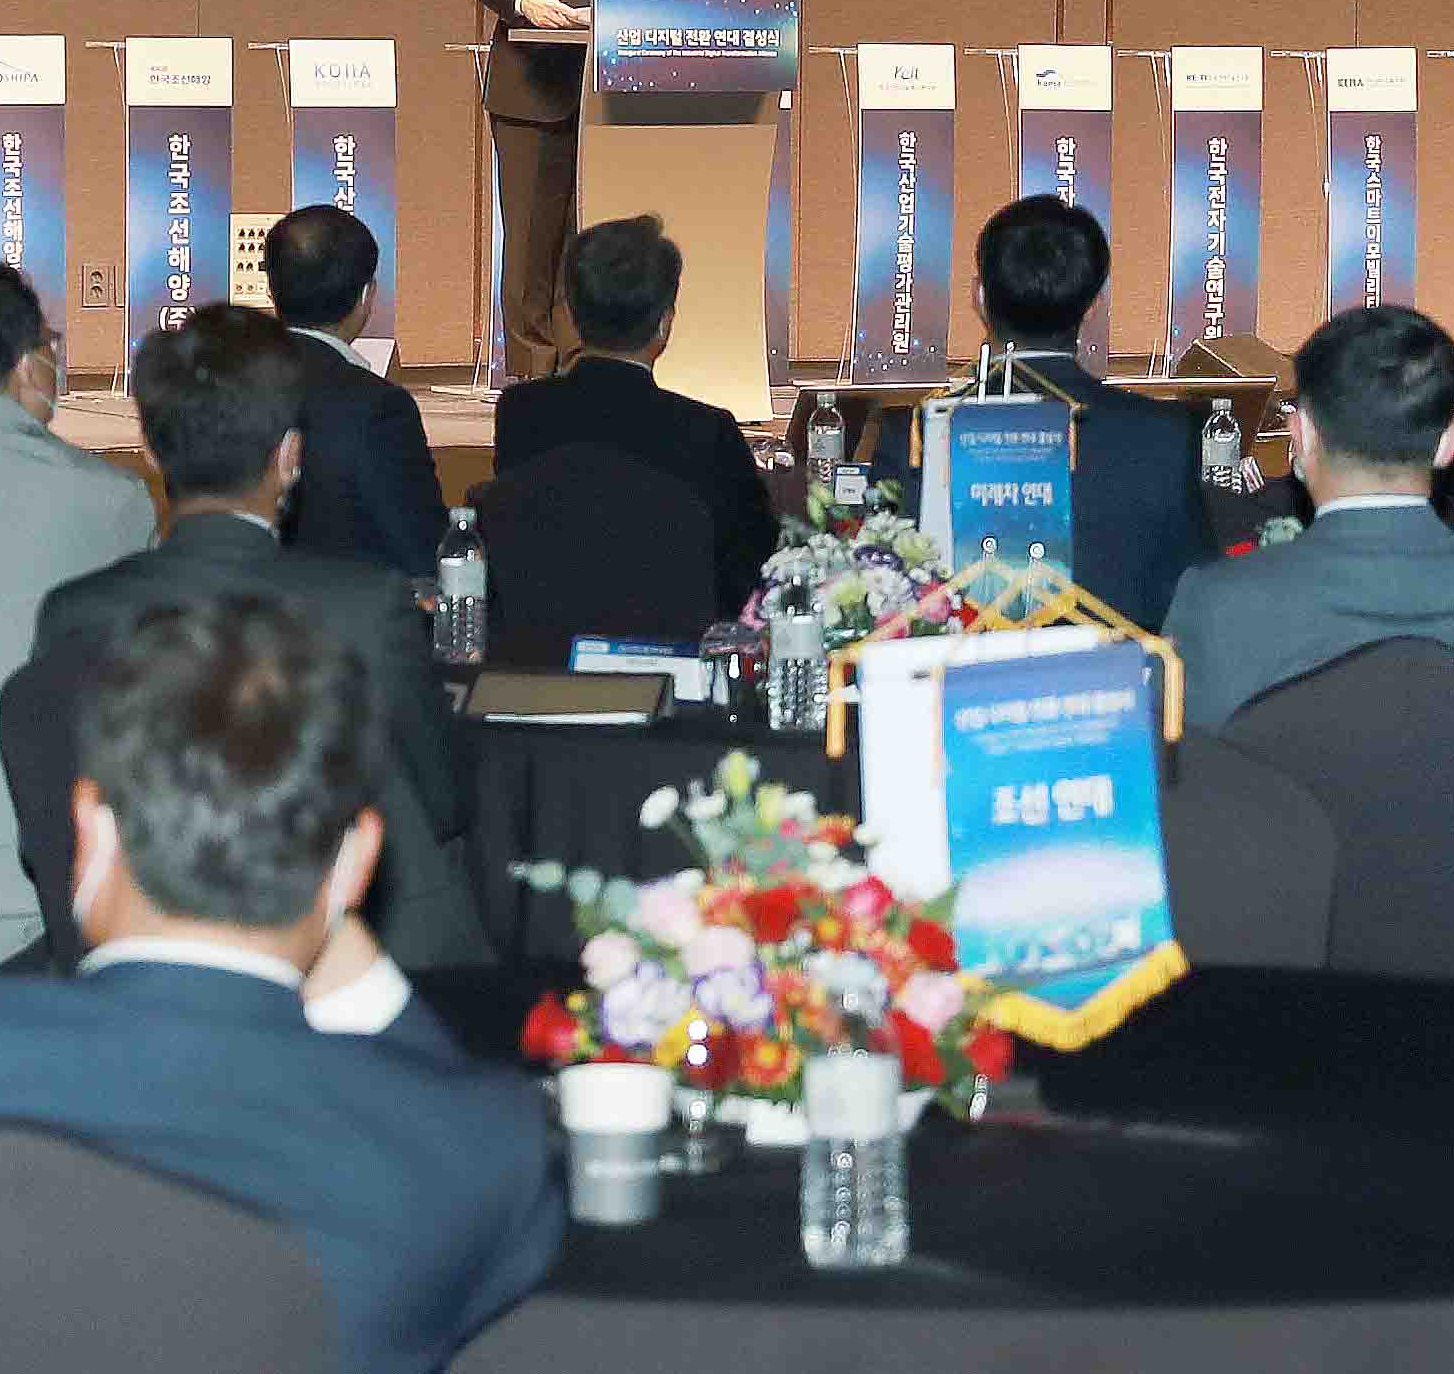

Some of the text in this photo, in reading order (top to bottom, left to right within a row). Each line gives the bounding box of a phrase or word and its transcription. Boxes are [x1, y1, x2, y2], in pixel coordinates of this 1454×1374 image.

[617, 28, 781, 48] 산업 디지털 전환 연대 결성식
[1, 132, 23, 270] 한국조선해양
[158, 132, 197, 332] 한국조선해양(주
[891, 131, 917, 355] 한국산업기술평가관리원
